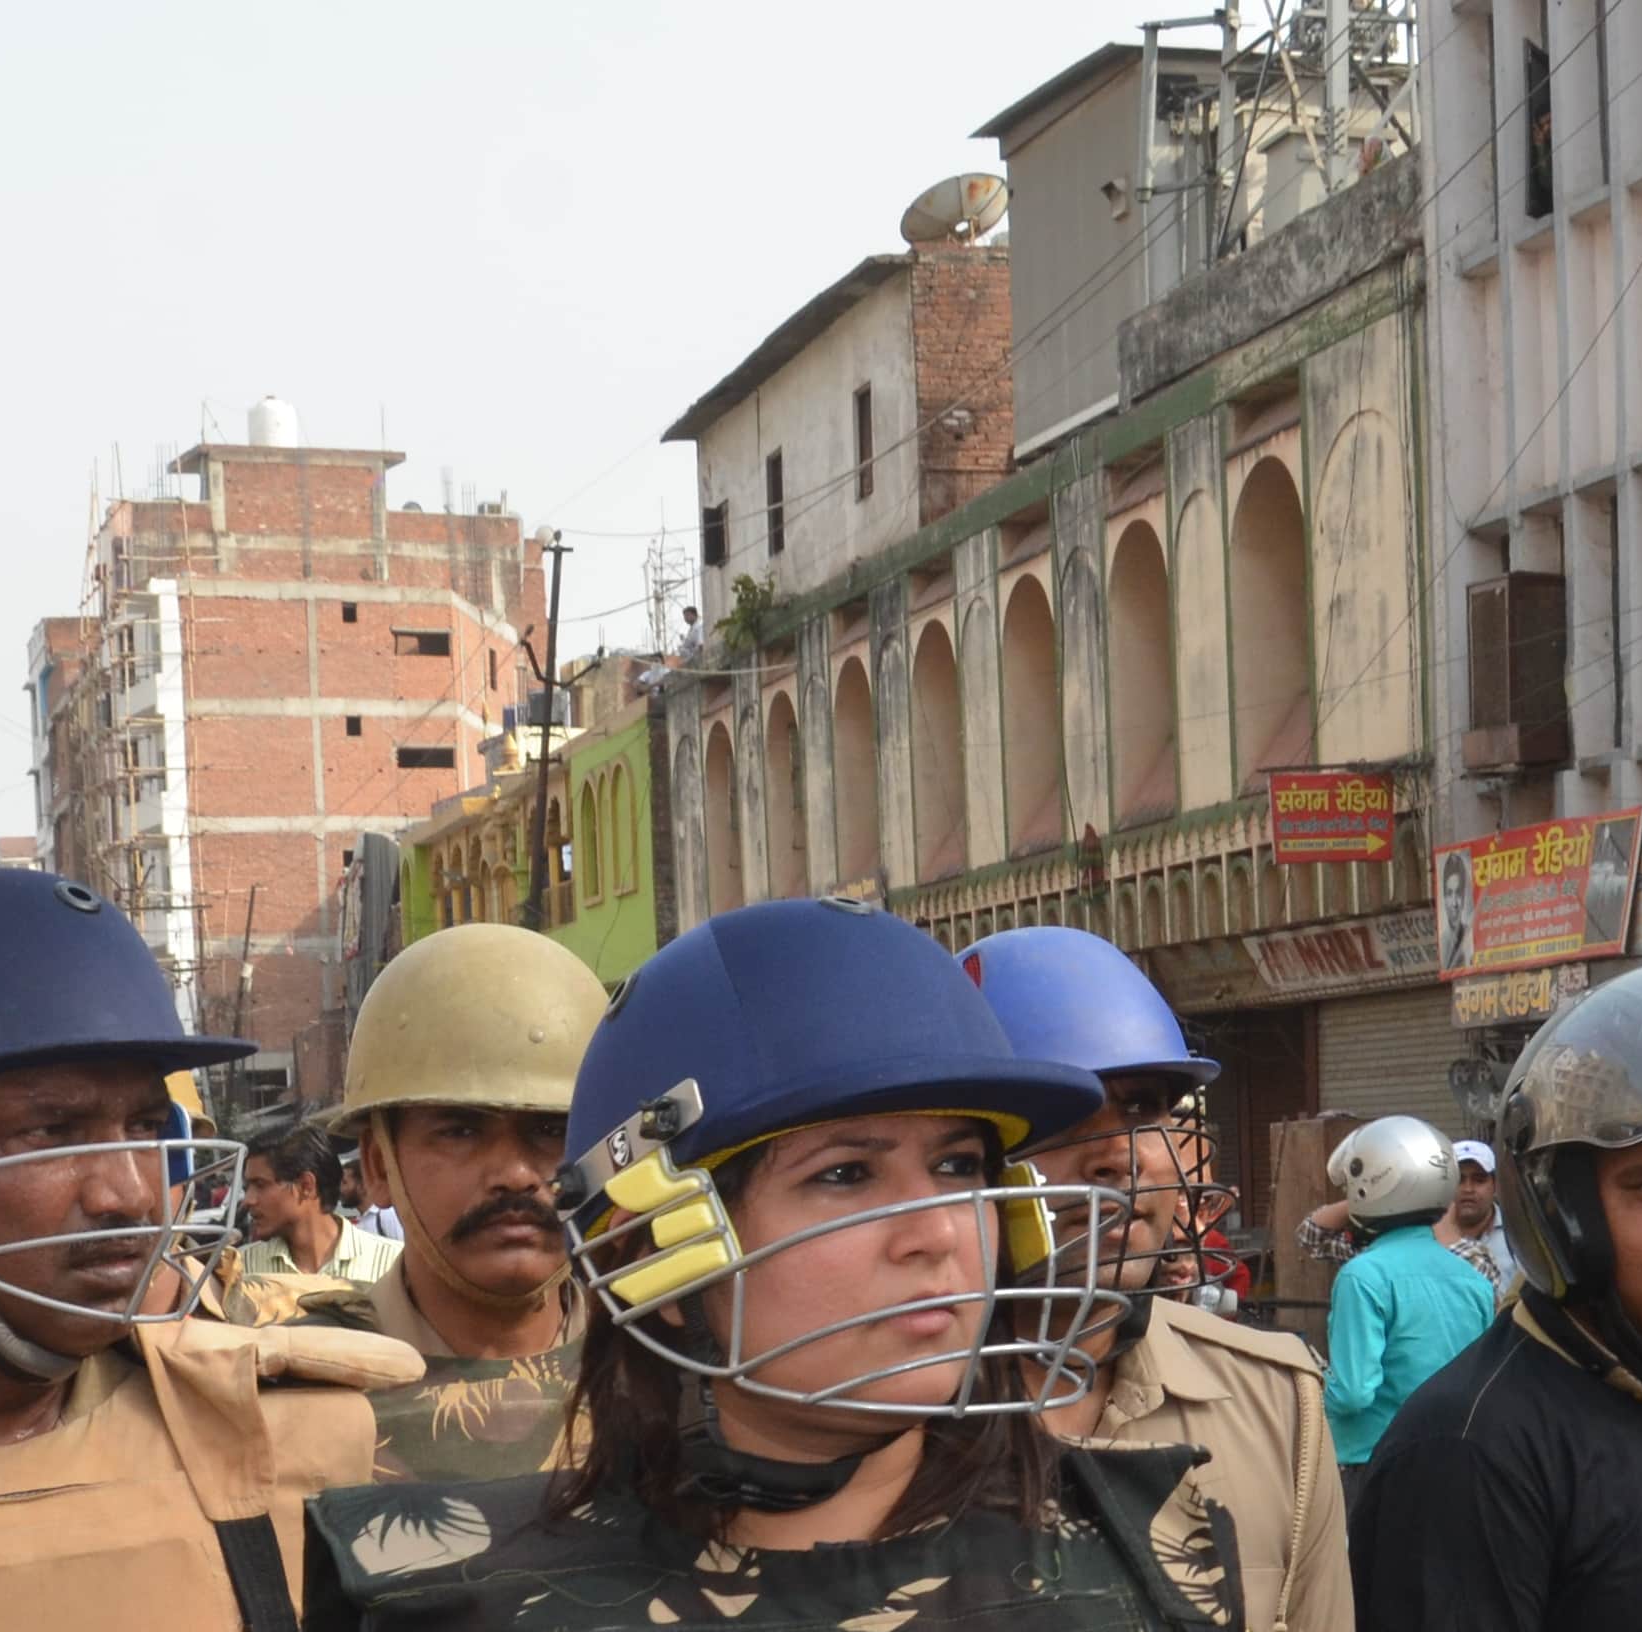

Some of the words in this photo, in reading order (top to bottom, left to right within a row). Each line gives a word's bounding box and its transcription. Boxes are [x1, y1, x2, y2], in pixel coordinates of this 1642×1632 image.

[1276, 782, 1329, 813] संगम
[1335, 780, 1389, 813] रेडियो
[1473, 839, 1527, 887] संगम
[1532, 824, 1591, 876] रेडियो
